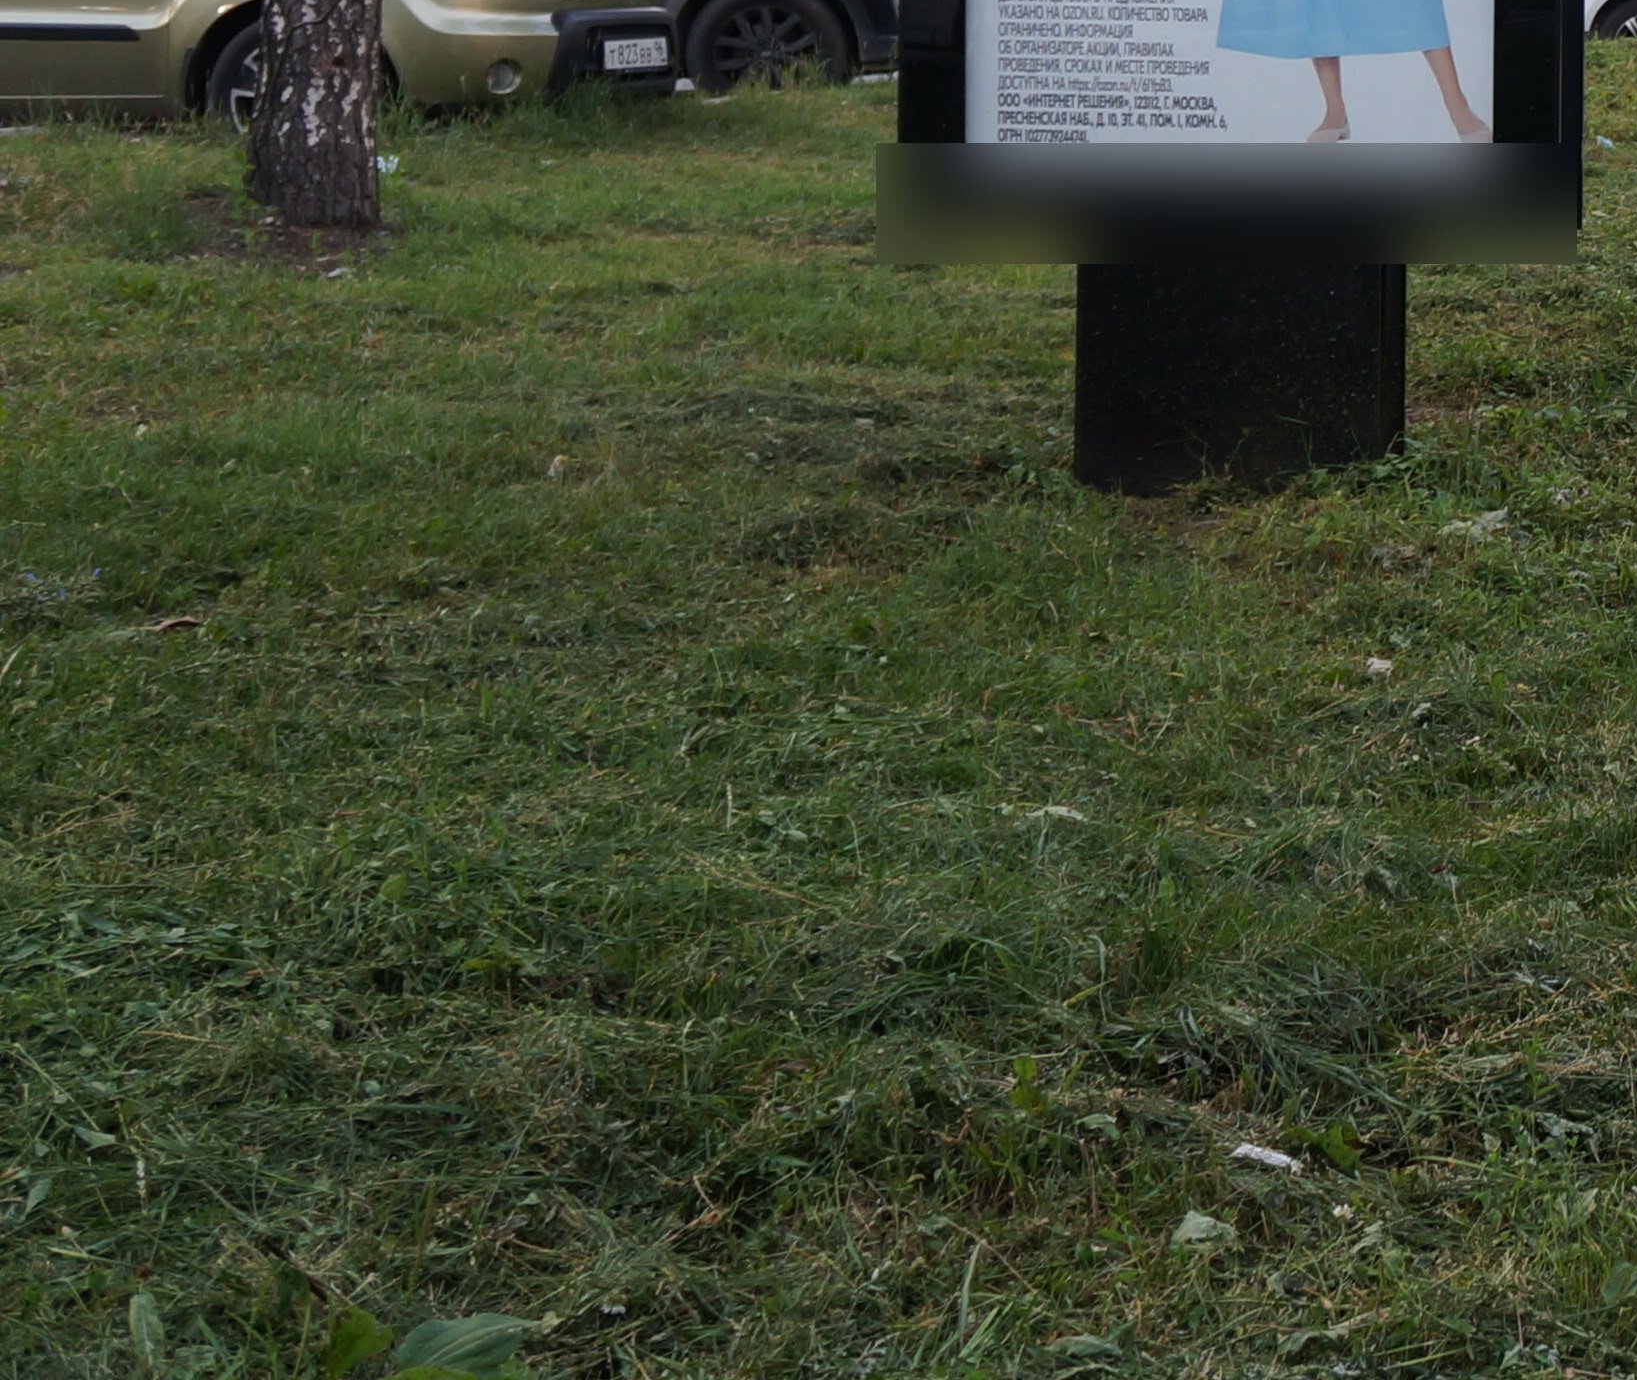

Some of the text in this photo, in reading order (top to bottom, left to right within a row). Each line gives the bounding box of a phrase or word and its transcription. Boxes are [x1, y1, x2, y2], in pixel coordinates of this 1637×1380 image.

[999, 5, 1044, 20] УКАЗАНО
[1047, 6, 1060, 20] НА
[1108, 7, 1170, 22] КОЛИЧЕСТВО
[1172, 8, 1208, 22] ТОВАРА
[1065, 22, 1133, 39] ИНФОРМАЦИЯ
[998, 40, 1011, 54] ОБ
[1014, 40, 1085, 55] ОРГАНИЗАТОРЕ
[1124, 42, 1174, 57] ПРАВИЛАХ
[1064, 58, 1102, 73] СРОКАХ
[1105, 60, 1112, 74] И
[1114, 60, 1145, 74] МЕСТЕ
[1148, 60, 1209, 76] ПРОВЕДЕНИЯ
[998, 75, 1049, 90] ДОСТУПНА
[1052, 76, 1065, 90] НА
[998, 93, 1020, 107] ООО
[1172, 96, 1217, 112] МОСКВА,
[998, 111, 1067, 125] ПРЕСНЕНСКАЯ
[1185, 114, 1217, 128] КОМН.
[998, 129, 1022, 142] ОГРН
